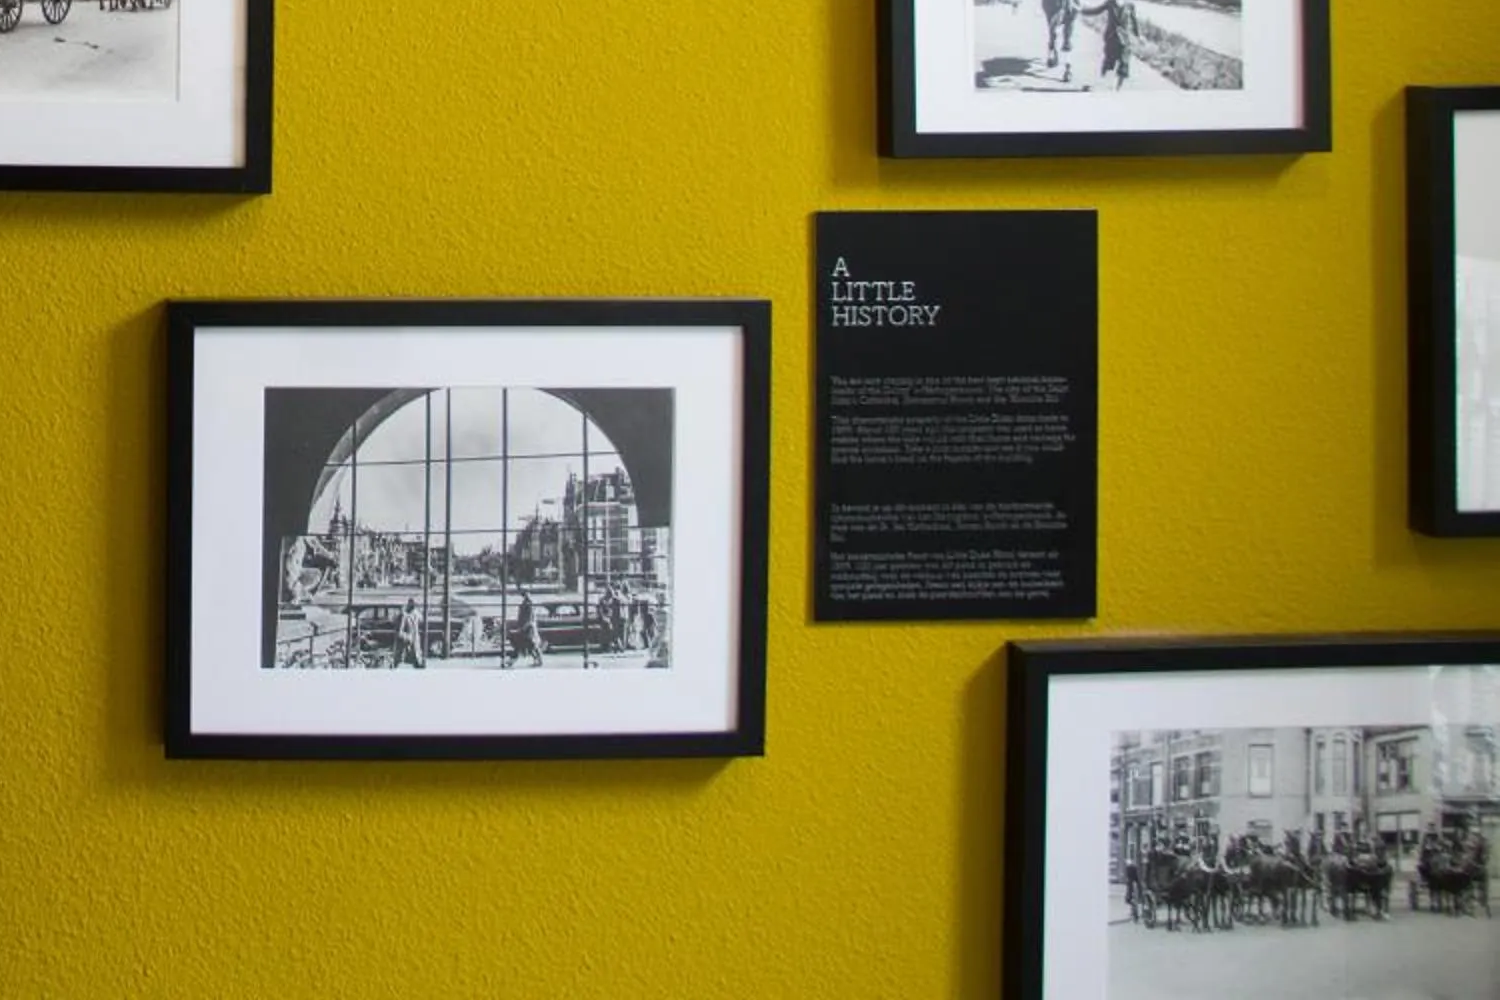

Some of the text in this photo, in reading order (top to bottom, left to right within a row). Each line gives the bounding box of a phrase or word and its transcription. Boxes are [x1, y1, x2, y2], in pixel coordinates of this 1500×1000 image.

[832, 256, 851, 277] A
[832, 281, 916, 301] LITTLE
[832, 305, 941, 327] HISTORY
